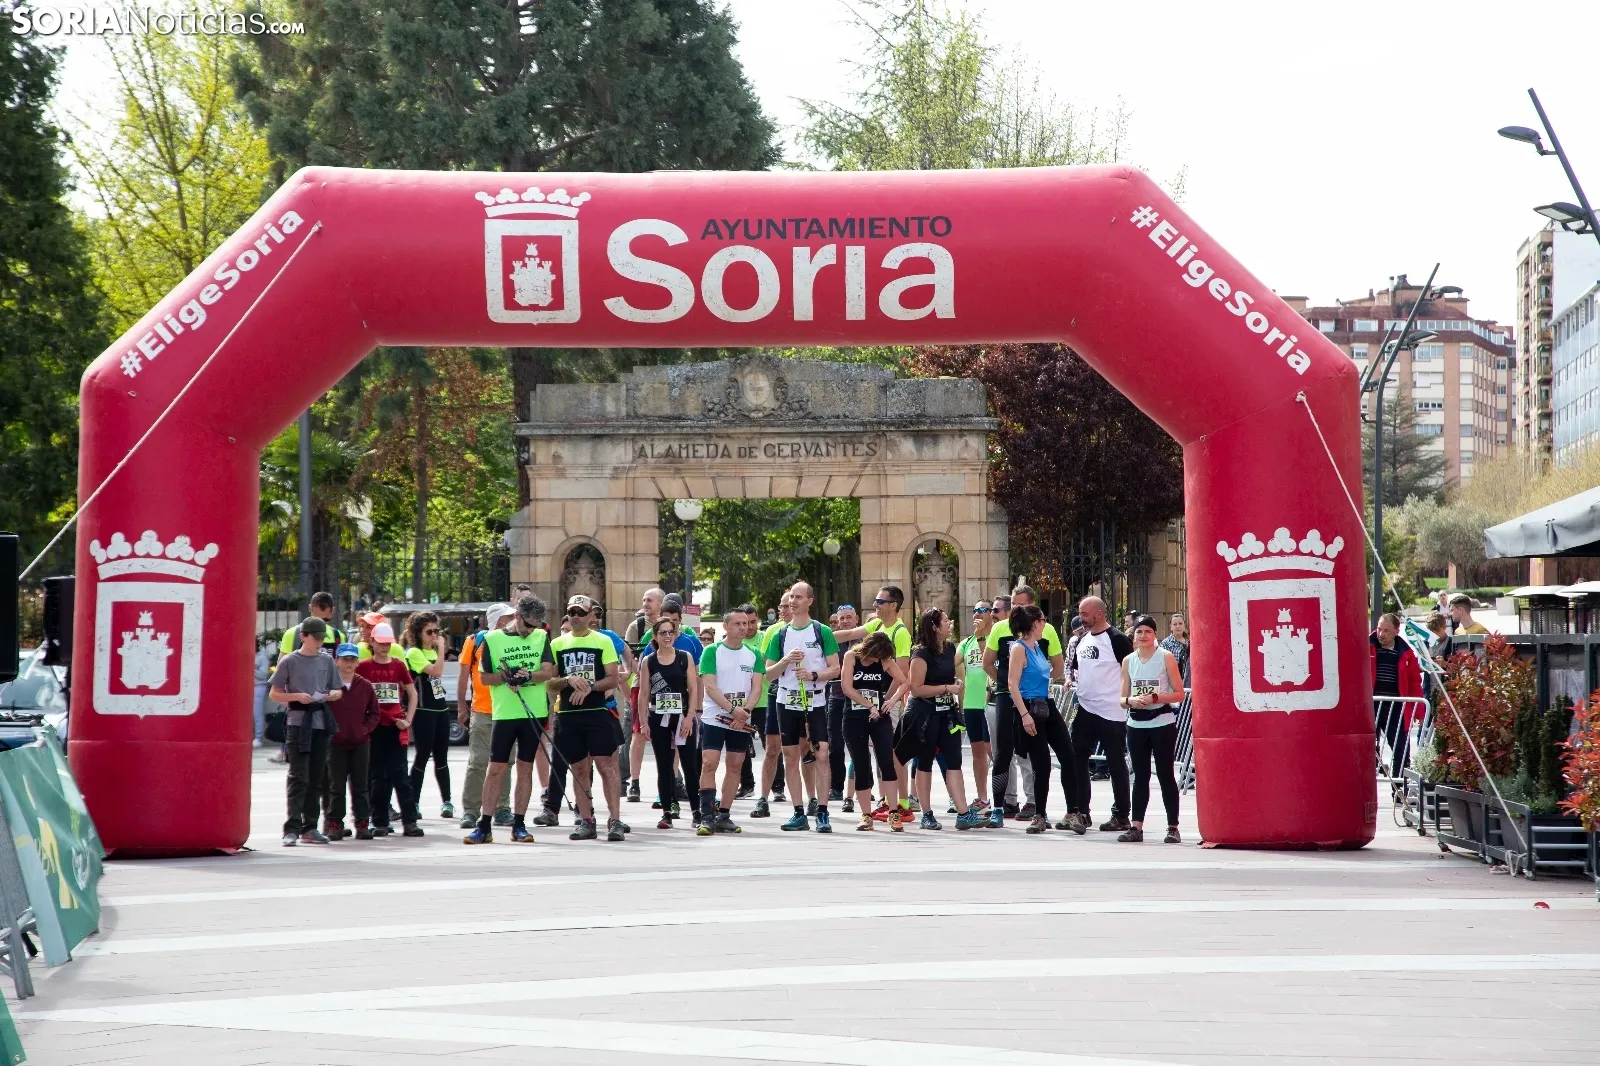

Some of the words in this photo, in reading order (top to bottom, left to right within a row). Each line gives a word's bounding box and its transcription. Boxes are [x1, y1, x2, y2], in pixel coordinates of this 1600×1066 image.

[700, 215, 953, 241] AYUNTAMIENTO
[603, 218, 956, 323] Soria
[119, 209, 305, 379] #EligeSoria
[1129, 205, 1311, 376] #EligeSoria
[637, 442, 733, 460] ALAMEDA
[737, 446, 759, 459] DE
[763, 441, 879, 459] CERVANTES
[503, 646, 521, 654] LIGA
[502, 652, 540, 662] NDERISMO
[375, 689, 394, 698] 213
[1137, 686, 1155, 695] 202
[660, 700, 678, 708] 233
[729, 698, 743, 707] 03
